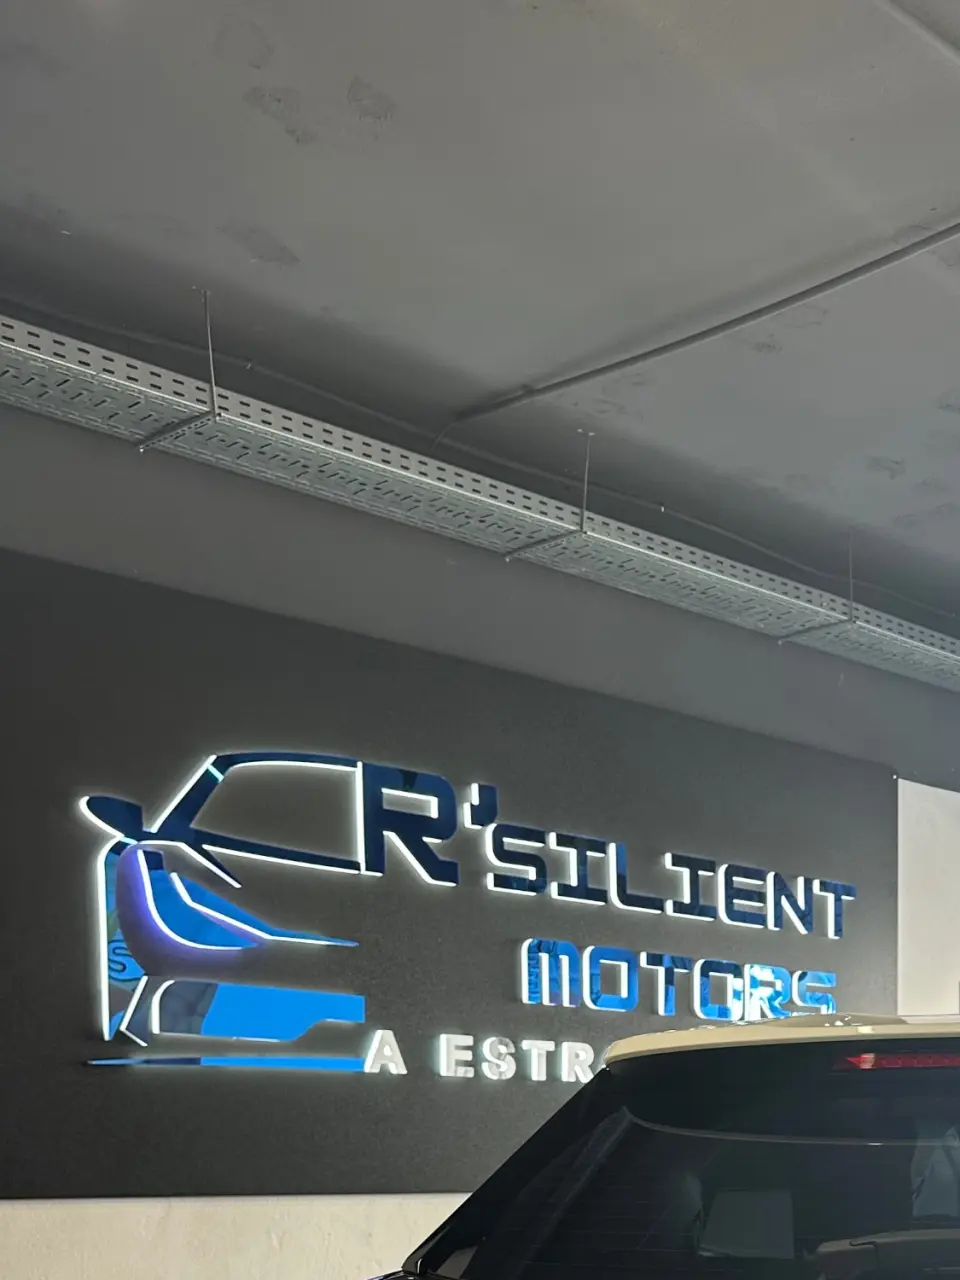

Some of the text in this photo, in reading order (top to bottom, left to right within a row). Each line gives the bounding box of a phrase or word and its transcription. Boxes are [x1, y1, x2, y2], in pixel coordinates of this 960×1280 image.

[356, 760, 857, 939] R'SILIENT
[521, 937, 837, 1022] MOTORS
[364, 1029, 606, 1084] A ESTR
